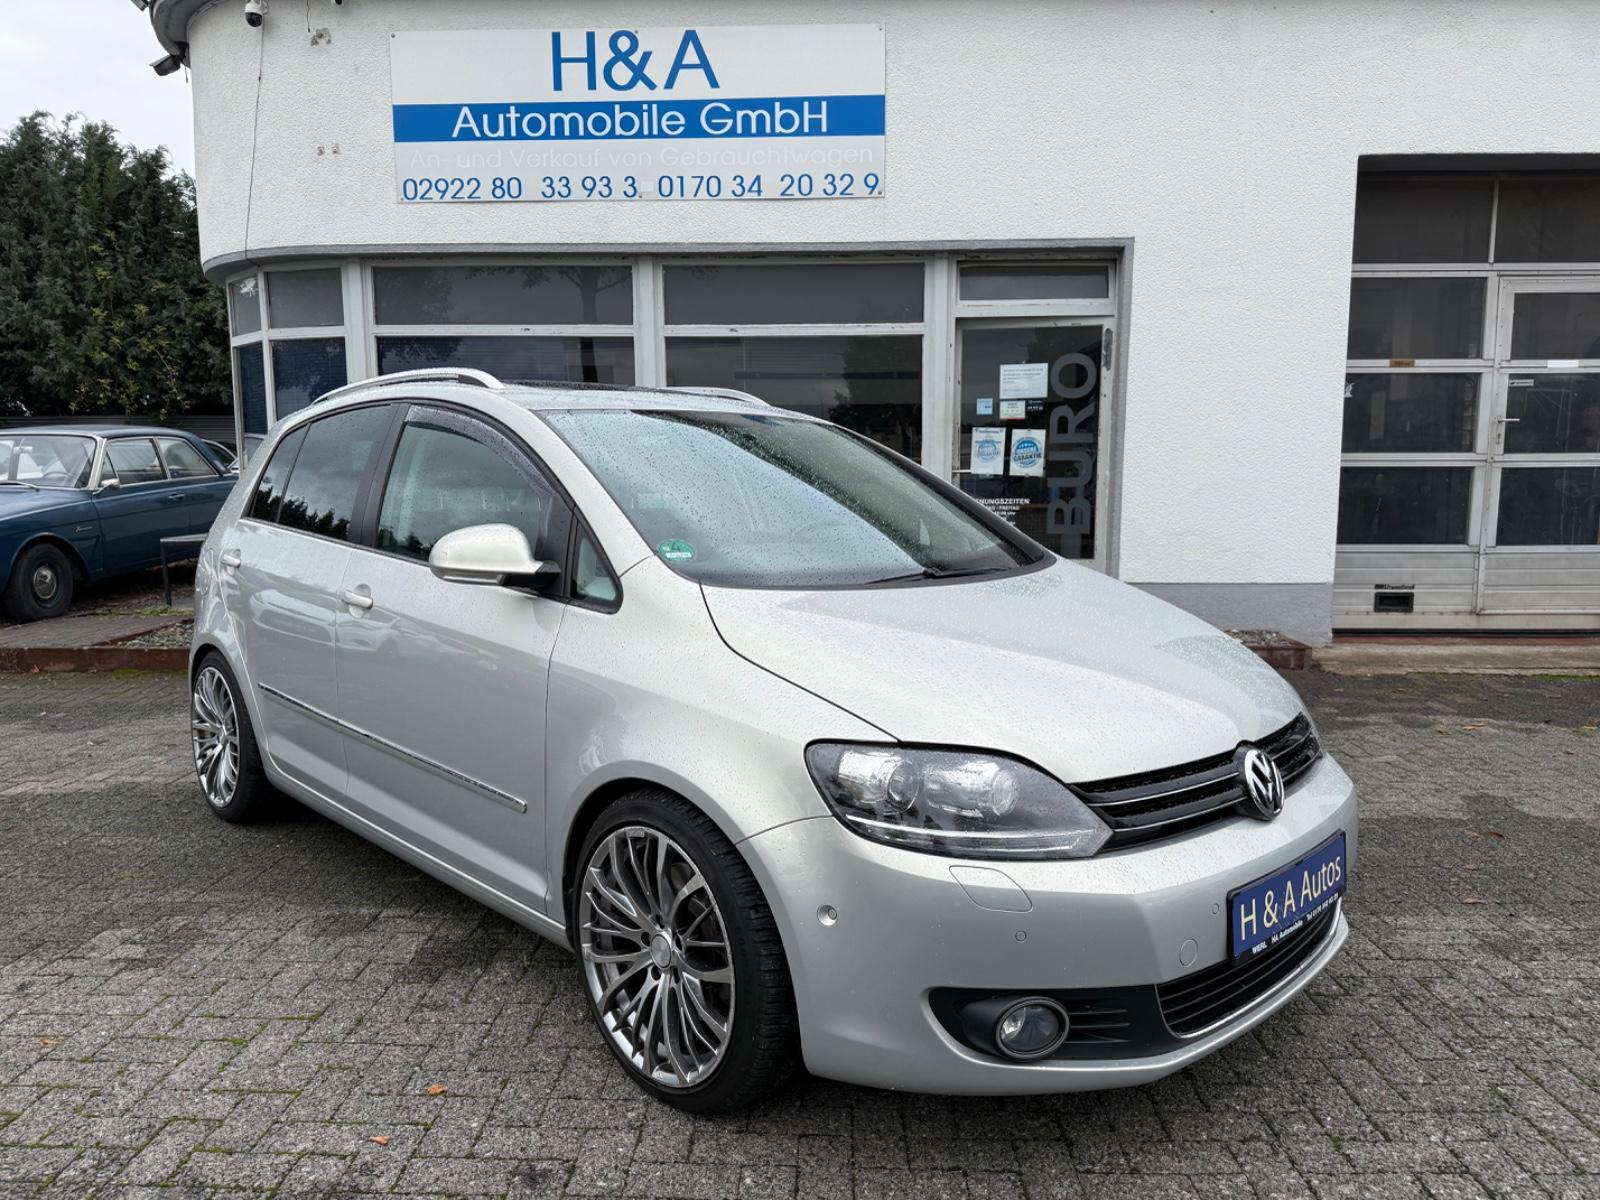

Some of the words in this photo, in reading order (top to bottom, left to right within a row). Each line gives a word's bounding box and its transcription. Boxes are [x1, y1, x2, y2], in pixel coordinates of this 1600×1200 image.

[551, 29, 720, 91] H&A
[452, 104, 686, 138] Automobile
[700, 100, 827, 135] GmbH
[410, 151, 449, 169] An-
[457, 149, 501, 169] und
[510, 148, 600, 169] Verkauf
[608, 150, 650, 167] von
[660, 146, 873, 169] Gebrauchtwagen
[402, 177, 481, 200] 02922
[491, 176, 522, 199] 80
[541, 176, 572, 198] 33
[581, 176, 612, 198] 93
[623, 176, 638, 198] 3
[658, 175, 721, 198] 0170
[731, 175, 763, 197] 34
[780, 174, 813, 196] 20
[822, 173, 854, 196] 32
[863, 173, 879, 196] 9
[1241, 898, 1256, 940] H
[1263, 890, 1278, 928] &
[1283, 880, 1296, 918] A
[1300, 856, 1341, 908] Autos
